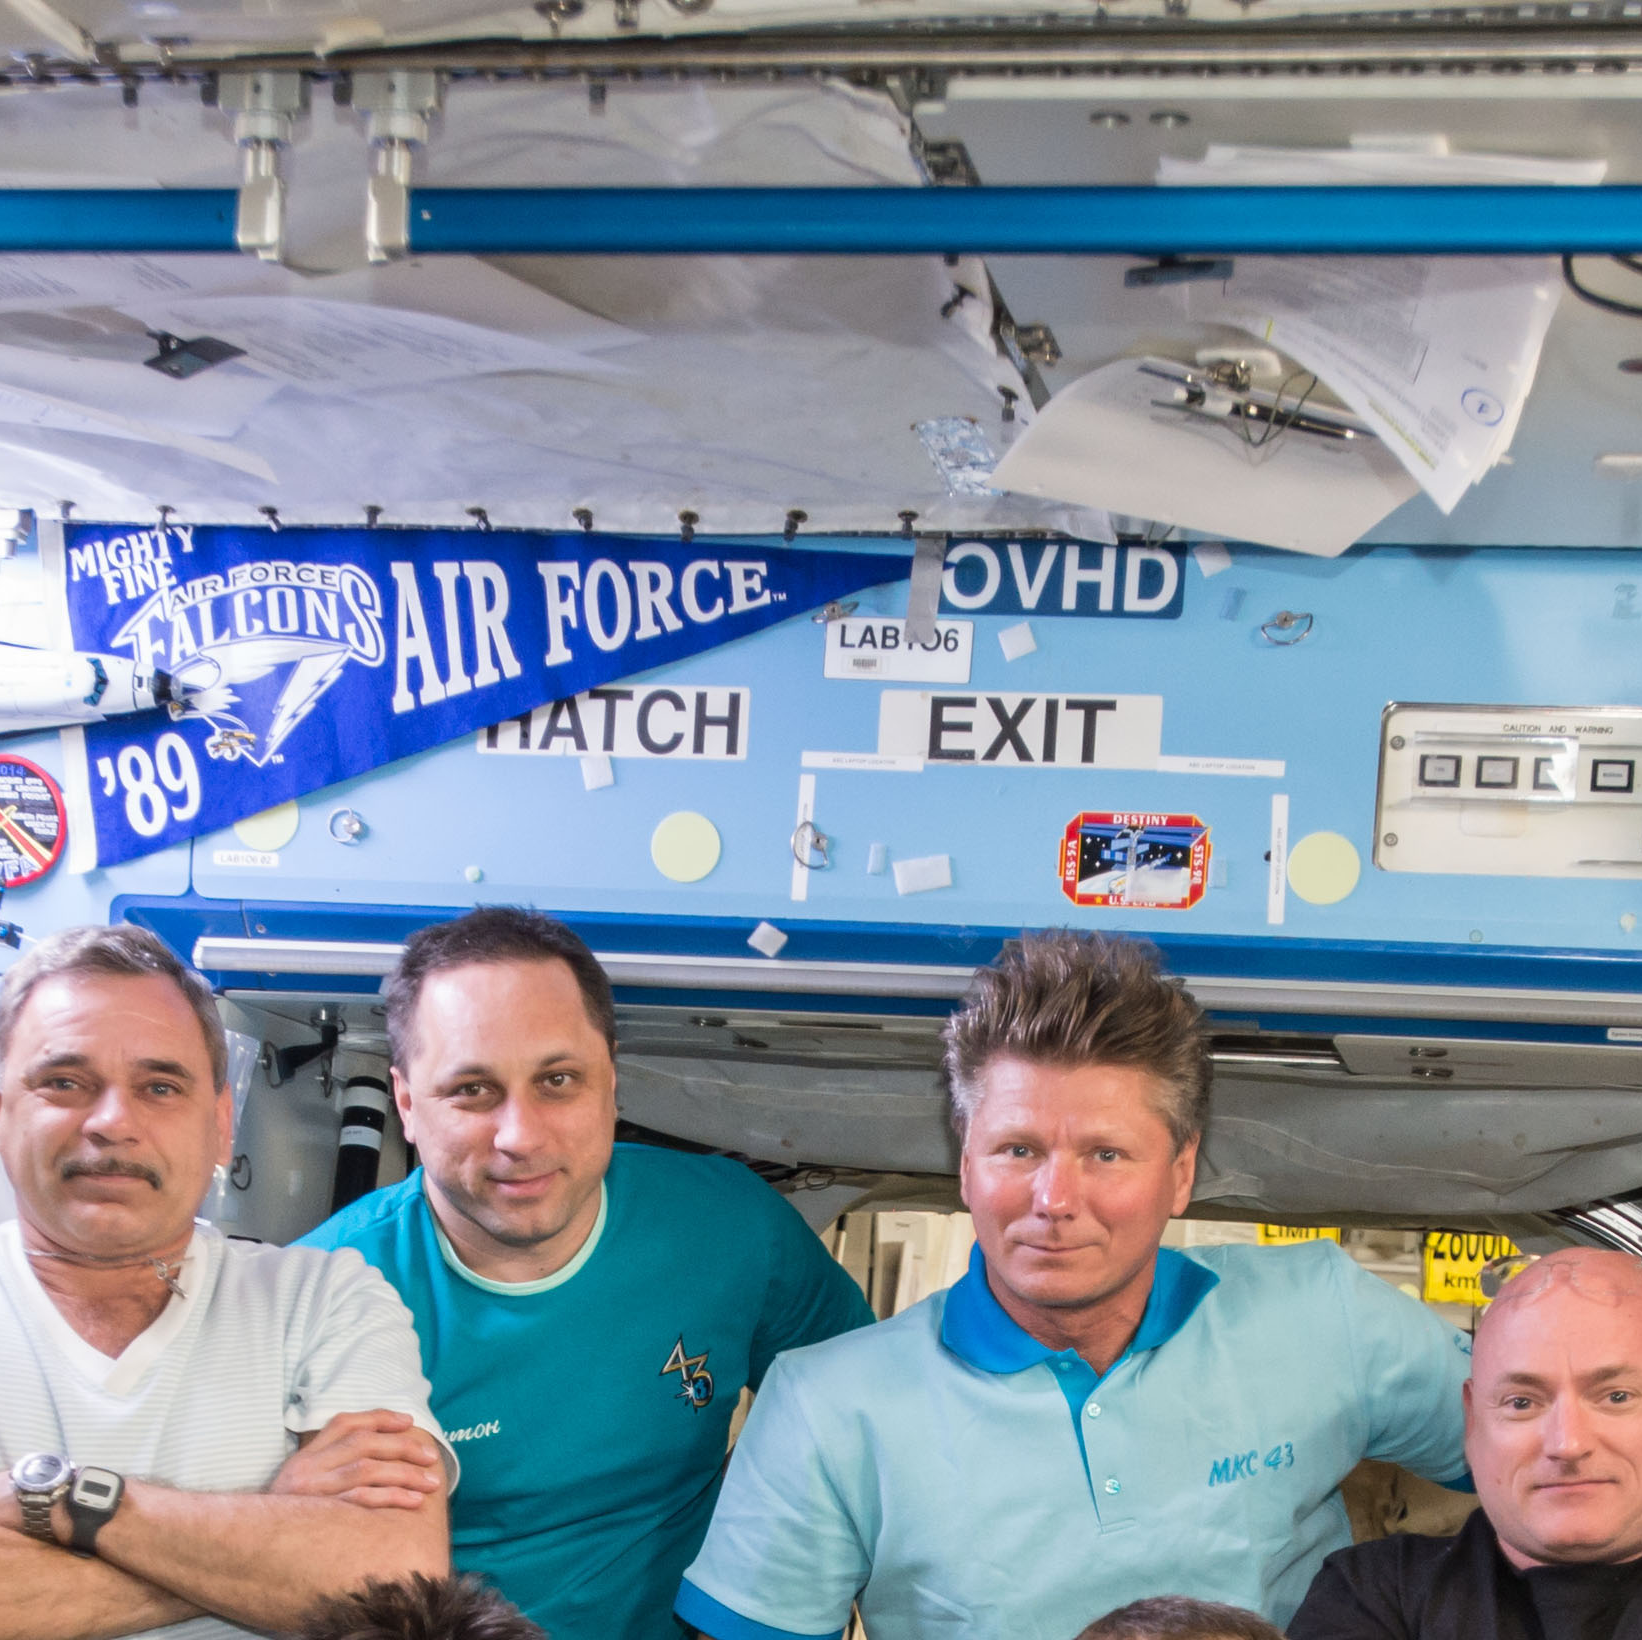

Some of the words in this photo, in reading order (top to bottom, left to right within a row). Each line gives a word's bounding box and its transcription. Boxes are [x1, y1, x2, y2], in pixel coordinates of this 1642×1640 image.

[69, 526, 194, 582] MIGHTY
[941, 542, 1179, 612] OVHD
[102, 559, 177, 604] FINE
[170, 577, 220, 607] AIR
[232, 566, 337, 588] FORCE
[129, 566, 381, 665] FALCONS
[391, 561, 521, 714] AIR
[538, 558, 771, 667] FORCE
[930, 696, 1117, 765] EXIT
[1503, 723, 1541, 734] CAUTION
[1549, 724, 1567, 734] AND
[1574, 725, 1614, 736] WARNING
[97, 732, 201, 838] '89
[1112, 814, 1169, 827] DESTINY
[1065, 839, 1078, 882] ISS-5A
[1264, 1441, 1295, 1470] 43
